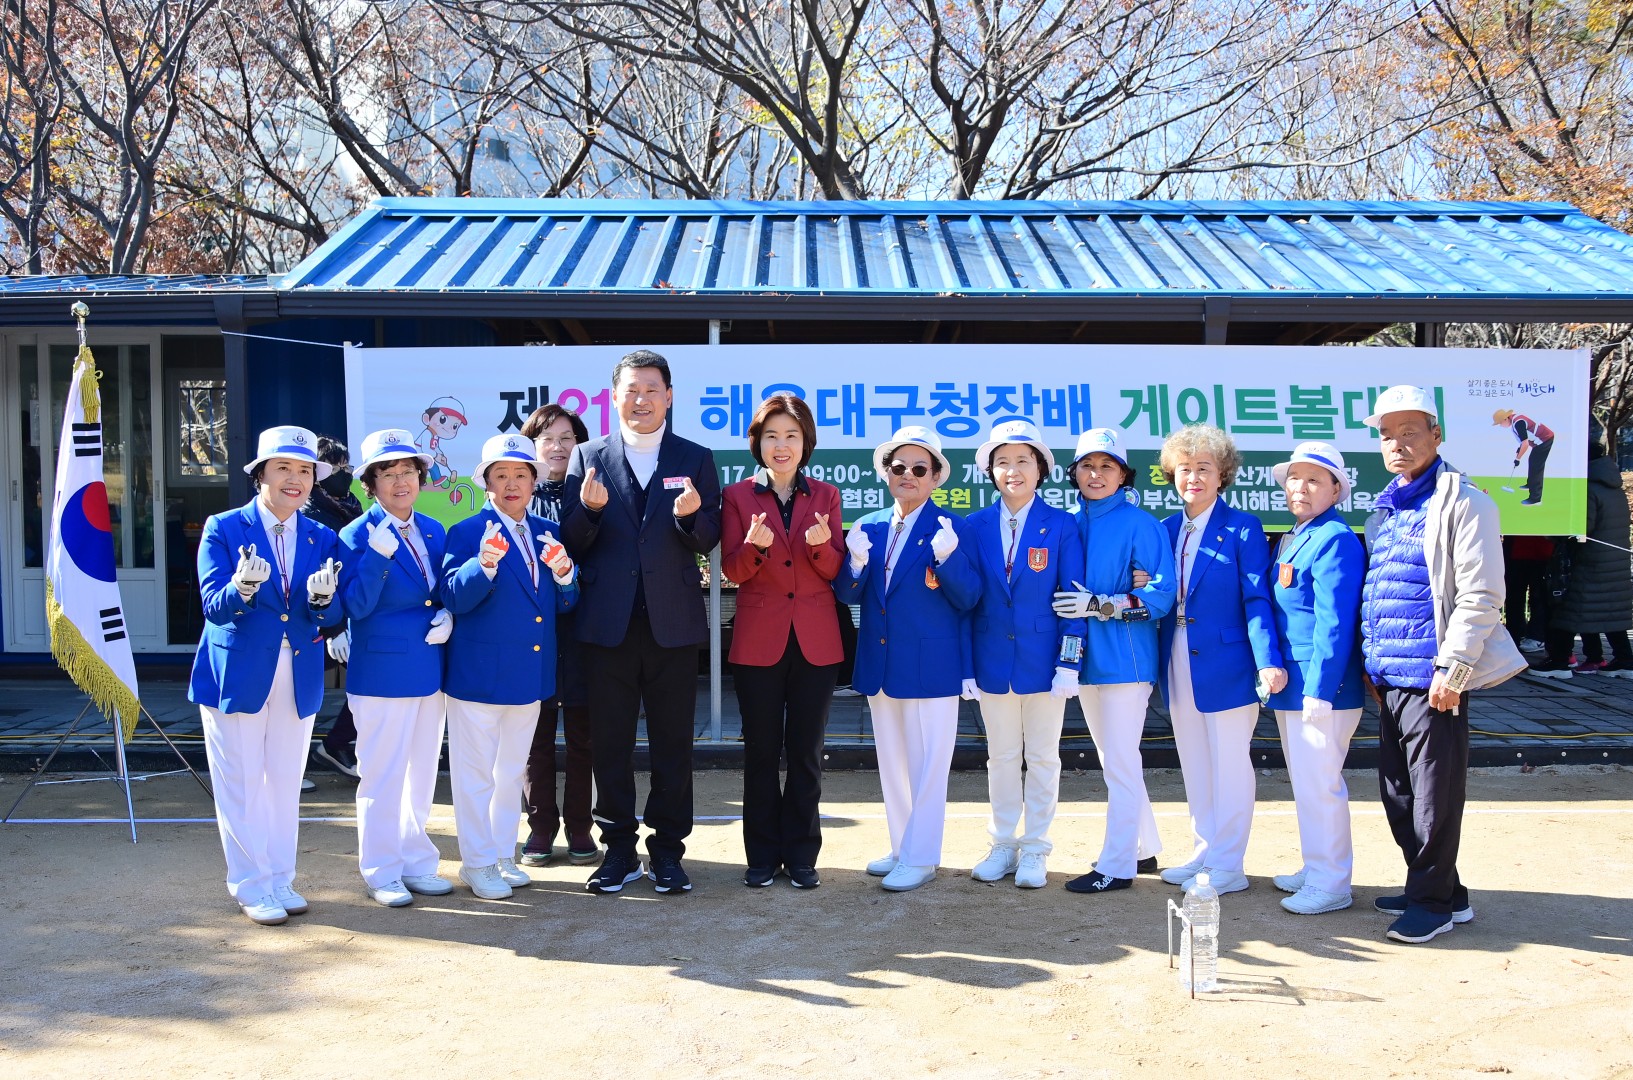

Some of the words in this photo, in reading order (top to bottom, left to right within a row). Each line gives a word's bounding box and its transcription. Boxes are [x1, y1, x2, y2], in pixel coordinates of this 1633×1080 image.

[1467, 380, 1482, 388] 살기
[1484, 380, 1498, 388] 좋은
[1500, 380, 1514, 388] 도시
[1517, 381, 1556, 395] 해운대
[1468, 389, 1483, 397] 오고
[1484, 389, 1498, 398] 싶은
[1500, 389, 1515, 398] 도시
[700, 383, 1092, 438] 해대구청장배
[1119, 384, 1446, 442] 게이트볼대
[931, 488, 971, 508] 후원
